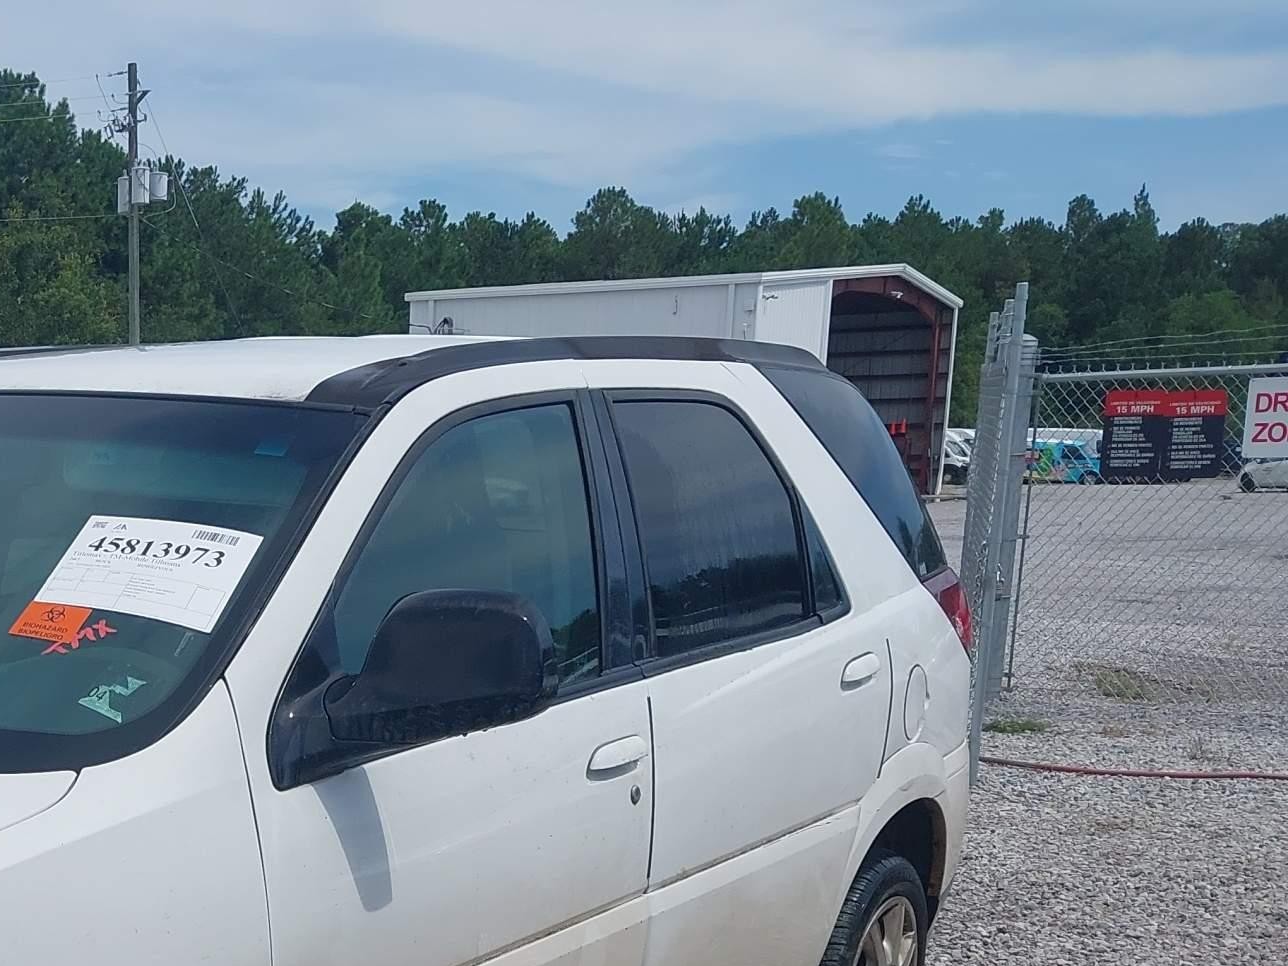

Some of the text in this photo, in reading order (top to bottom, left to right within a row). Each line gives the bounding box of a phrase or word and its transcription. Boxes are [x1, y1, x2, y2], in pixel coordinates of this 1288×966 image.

[1255, 392, 1288, 413] DR
[1116, 405, 1154, 414] 15 MPH
[1175, 405, 1215, 415] 15 MPH
[1251, 422, 1288, 443] ZO
[88, 535, 226, 568] 45813973
[22, 622, 68, 633] BIOHAZARD
[18, 628, 64, 640] BIOPELIGRO
